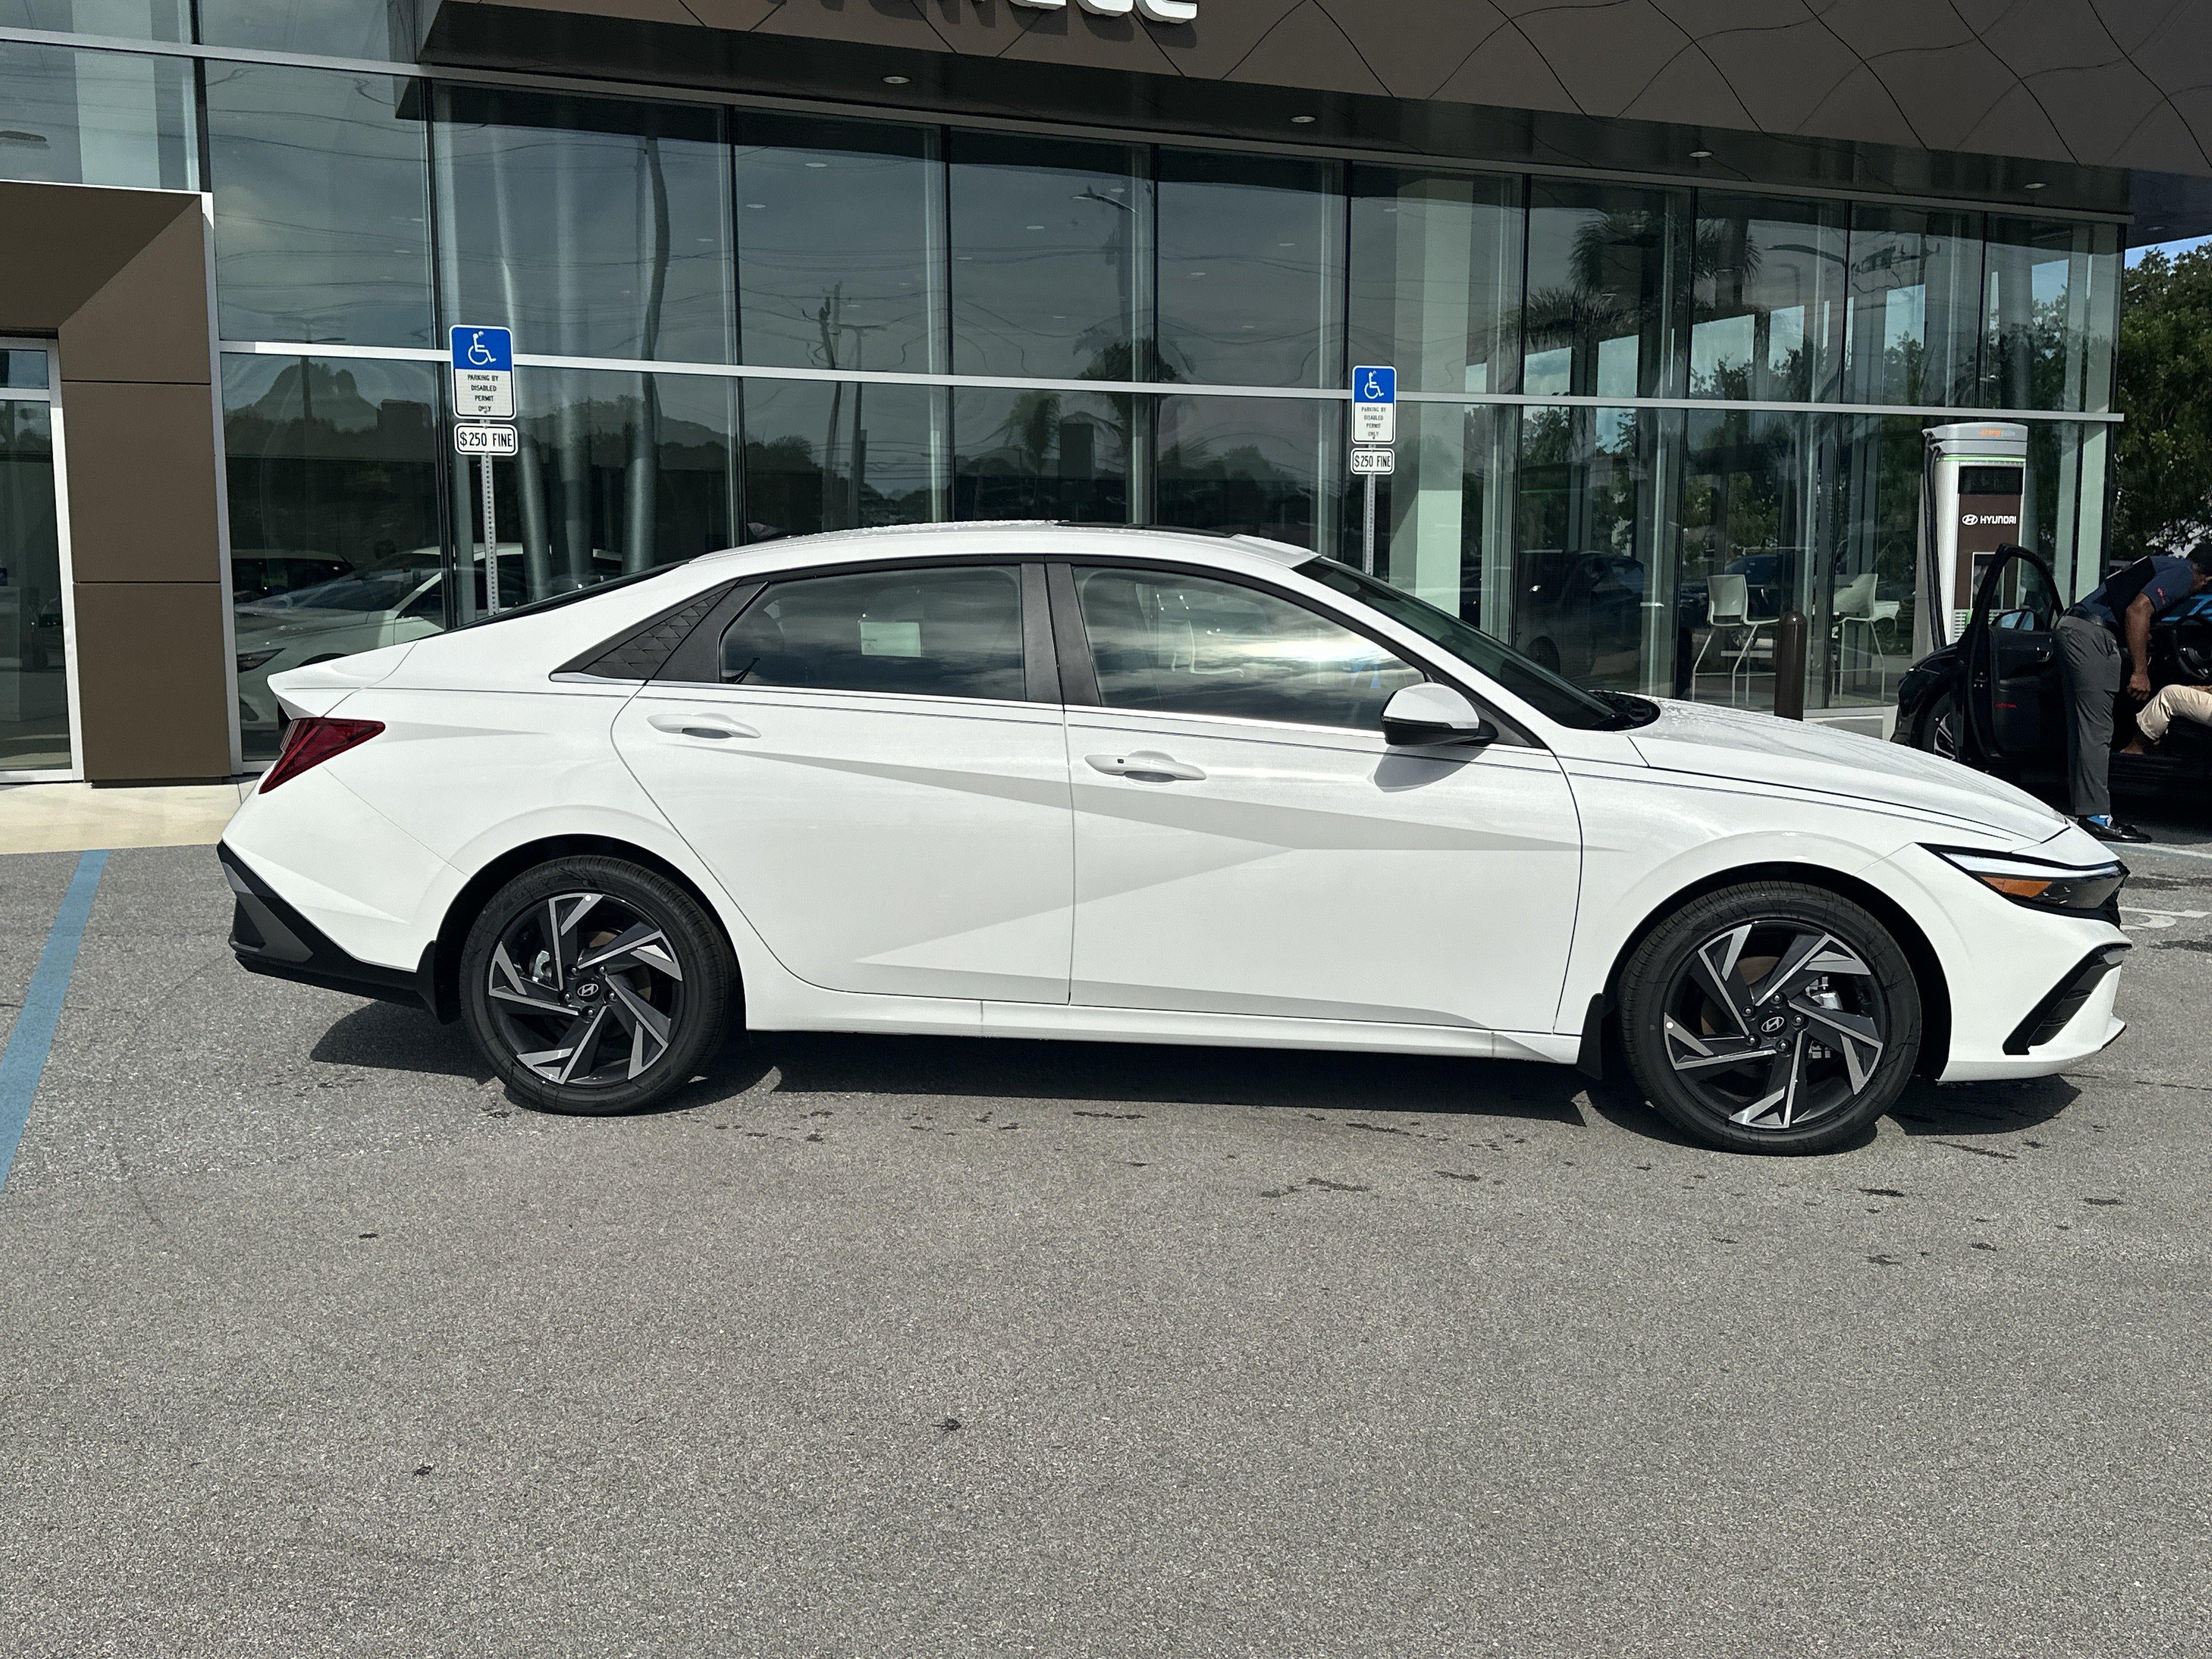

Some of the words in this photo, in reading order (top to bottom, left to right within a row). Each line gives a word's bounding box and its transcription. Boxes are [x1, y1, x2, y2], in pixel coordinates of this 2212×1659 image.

[460, 431, 487, 447] $250
[493, 433, 513, 447] FINE
[1354, 454, 1373, 468] $250
[1376, 455, 1391, 467] FINE
[1979, 515, 2017, 524] HYUNDAI
